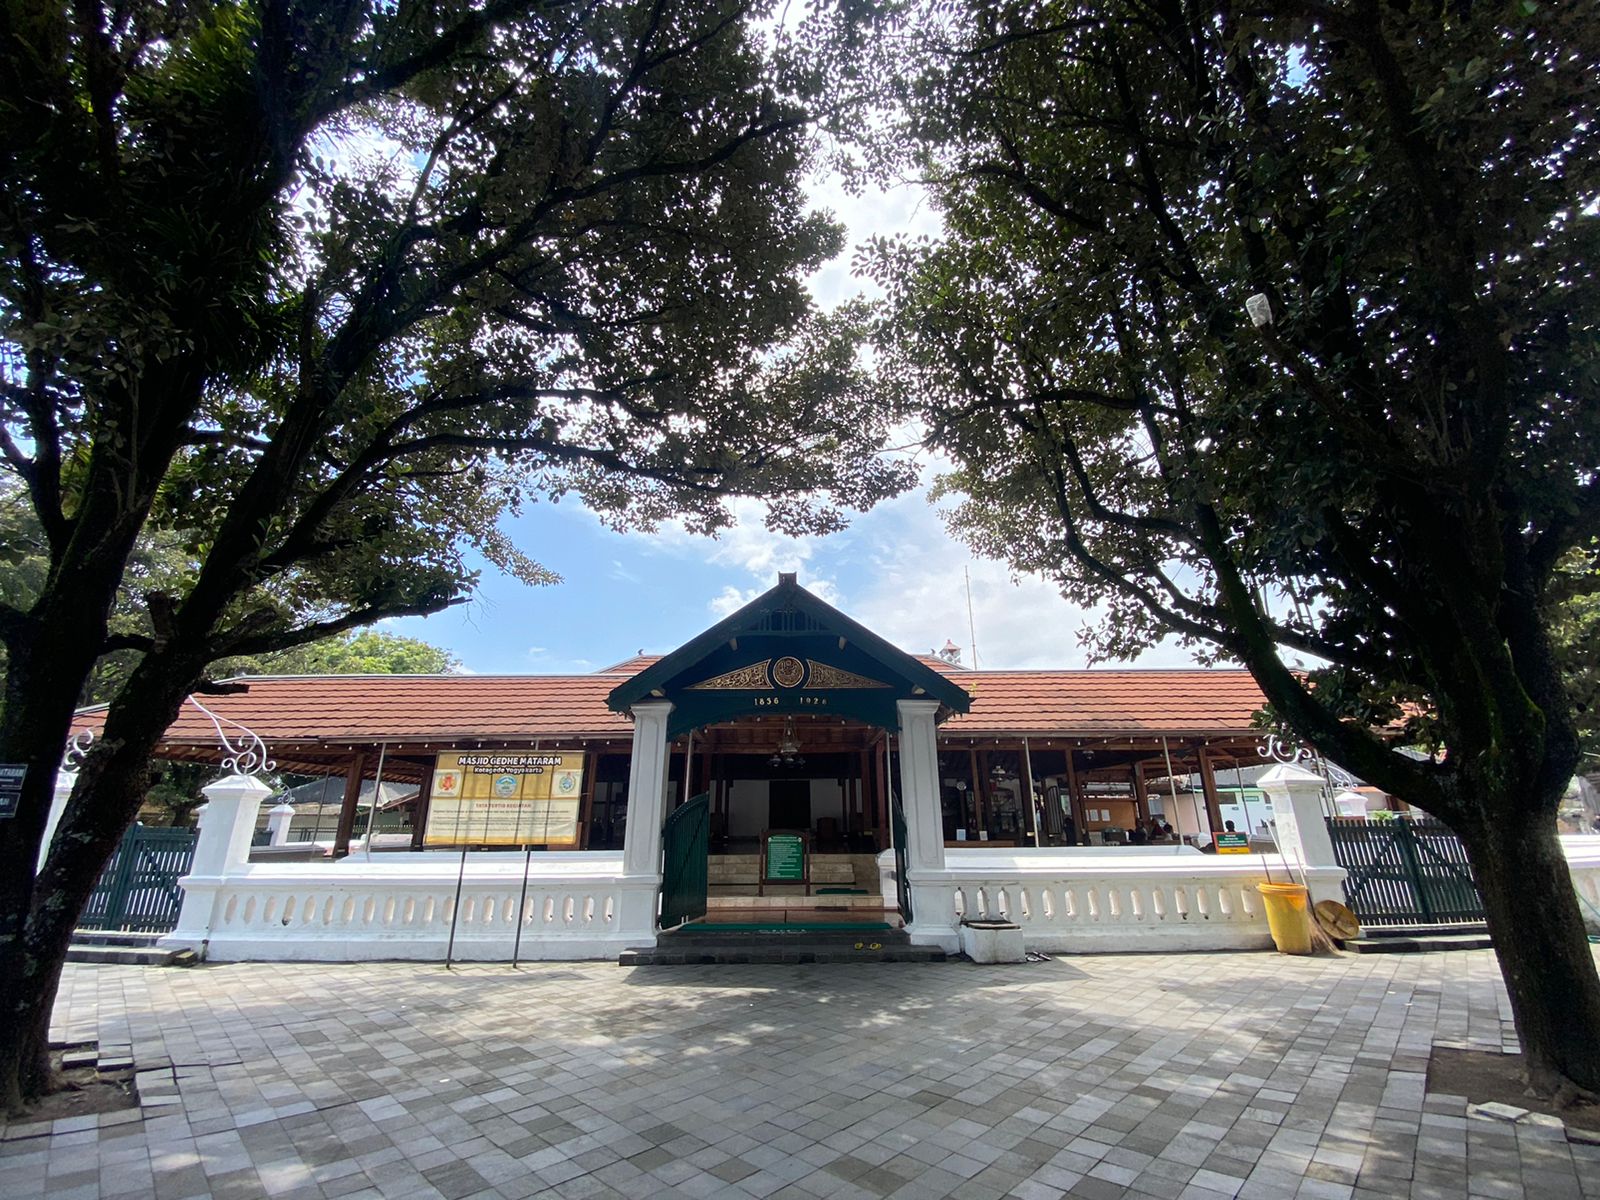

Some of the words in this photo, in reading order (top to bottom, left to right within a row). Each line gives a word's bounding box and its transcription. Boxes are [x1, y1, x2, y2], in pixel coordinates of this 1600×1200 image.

[754, 697, 779, 706] 1856
[458, 756, 489, 765] MASJID
[490, 756, 518, 765] GEDHE
[519, 756, 562, 765] MATARAM
[505, 767, 543, 775] Yogyakarta
